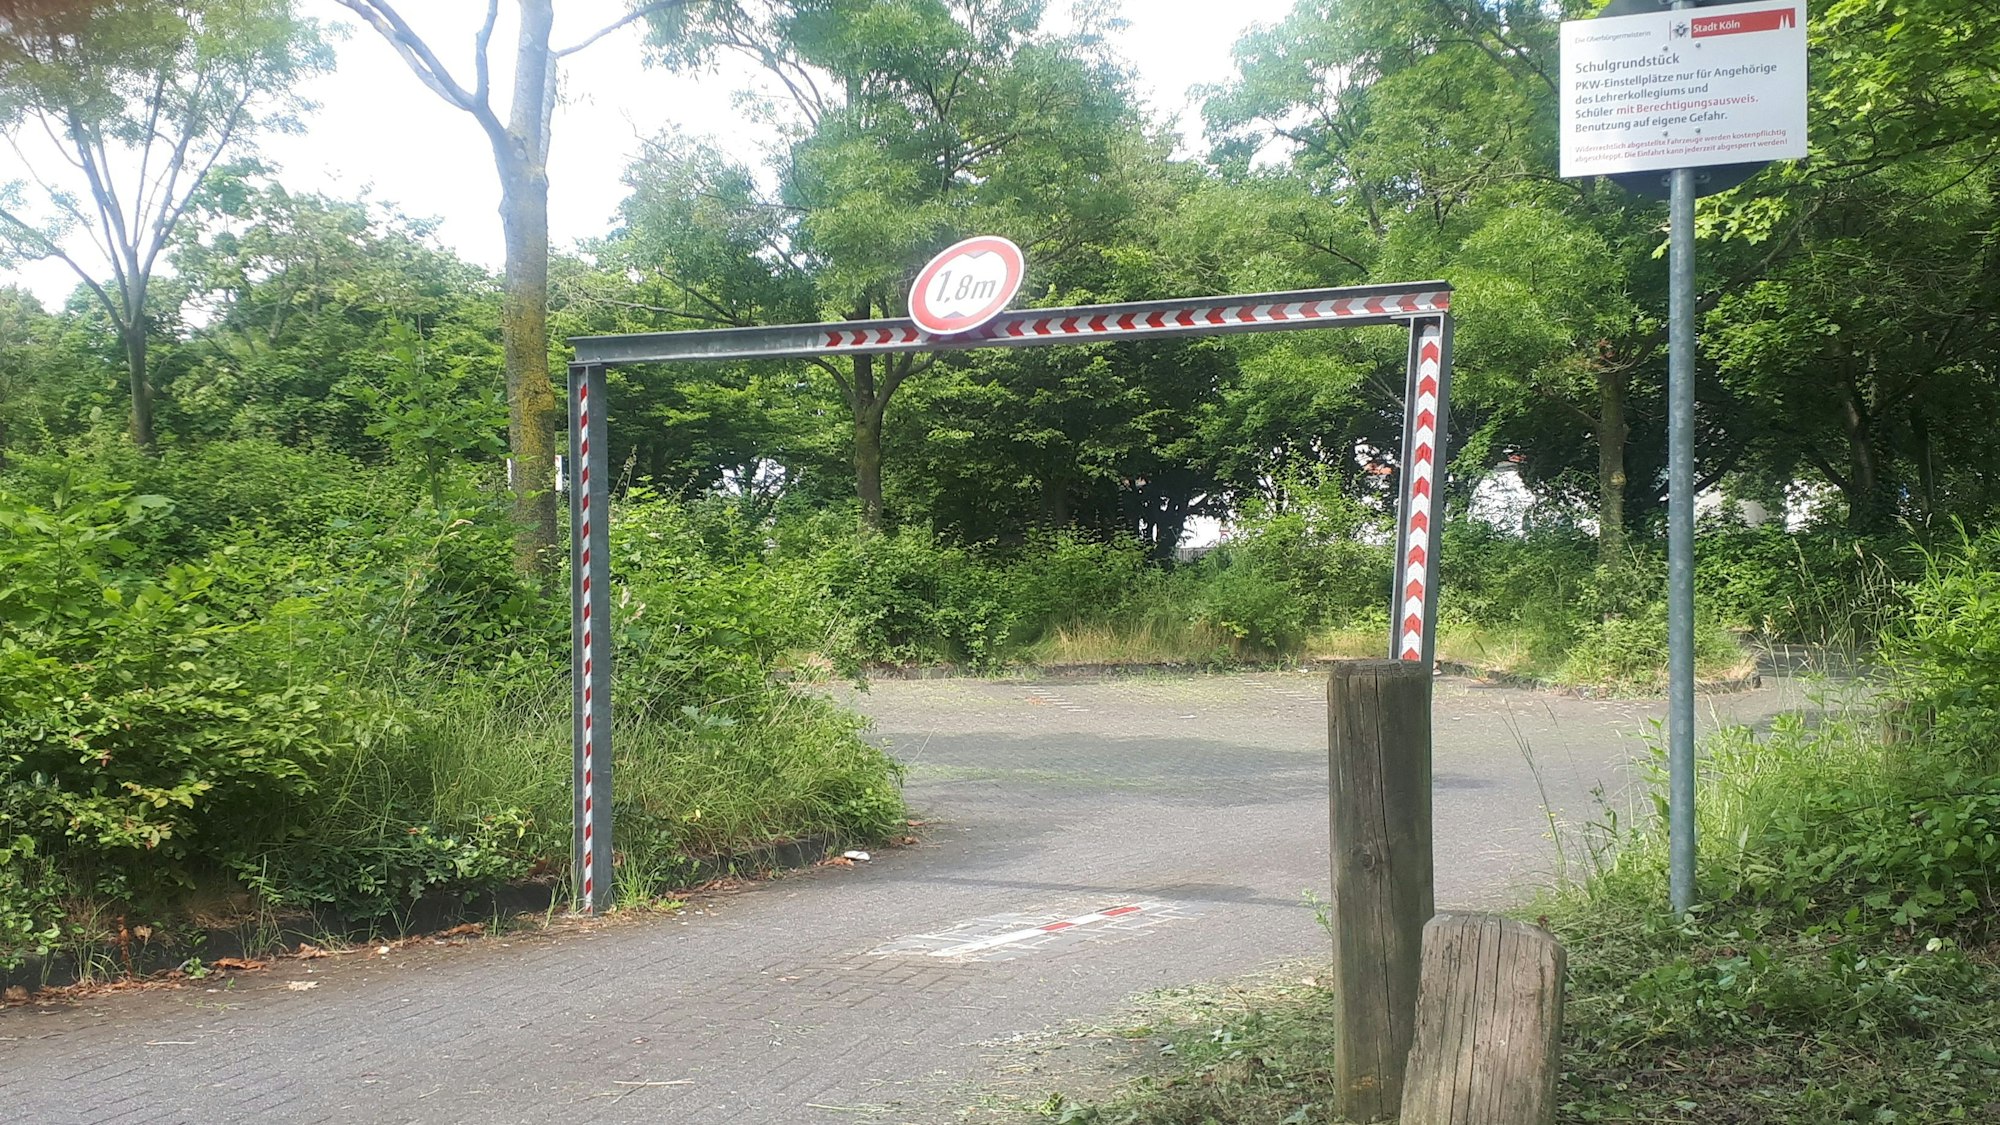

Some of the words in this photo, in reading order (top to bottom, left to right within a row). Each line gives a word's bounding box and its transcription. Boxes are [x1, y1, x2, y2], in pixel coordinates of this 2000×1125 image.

[1693, 22, 1717, 33] Stadt
[1719, 20, 1741, 31] Köln
[1576, 52, 1680, 73] Schulgrundstück
[1575, 73, 1674, 90] PKW-Einstellplätze
[1676, 71, 1694, 81] nur
[1696, 69, 1712, 79] für
[1714, 63, 1777, 78] Angehörige
[1575, 95, 1593, 105] des
[1595, 87, 1685, 103] Lehrerkollegiums
[1688, 83, 1709, 94] und
[1575, 107, 1613, 119] Schüler
[1616, 104, 1636, 115] mit
[1636, 94, 1759, 113] Berechtigungsausweis.
[1575, 120, 1631, 133] Benutzung
[1633, 116, 1650, 127] auf
[1652, 115, 1687, 127] eigene
[1689, 111, 1728, 122] Gefahr.
[1627, 139, 1665, 149] abgestellte
[1667, 136, 1702, 145] Fahrzeuge
[1705, 133, 1731, 142] werden
[1732, 129, 1786, 139] kostenpflichtig
[1637, 148, 1665, 157] Einfahrt
[1666, 147, 1683, 155] kann
[1684, 145, 1716, 154] jederzeit
[1716, 141, 1756, 151] abgesperrt
[1757, 138, 1788, 147] werden!
